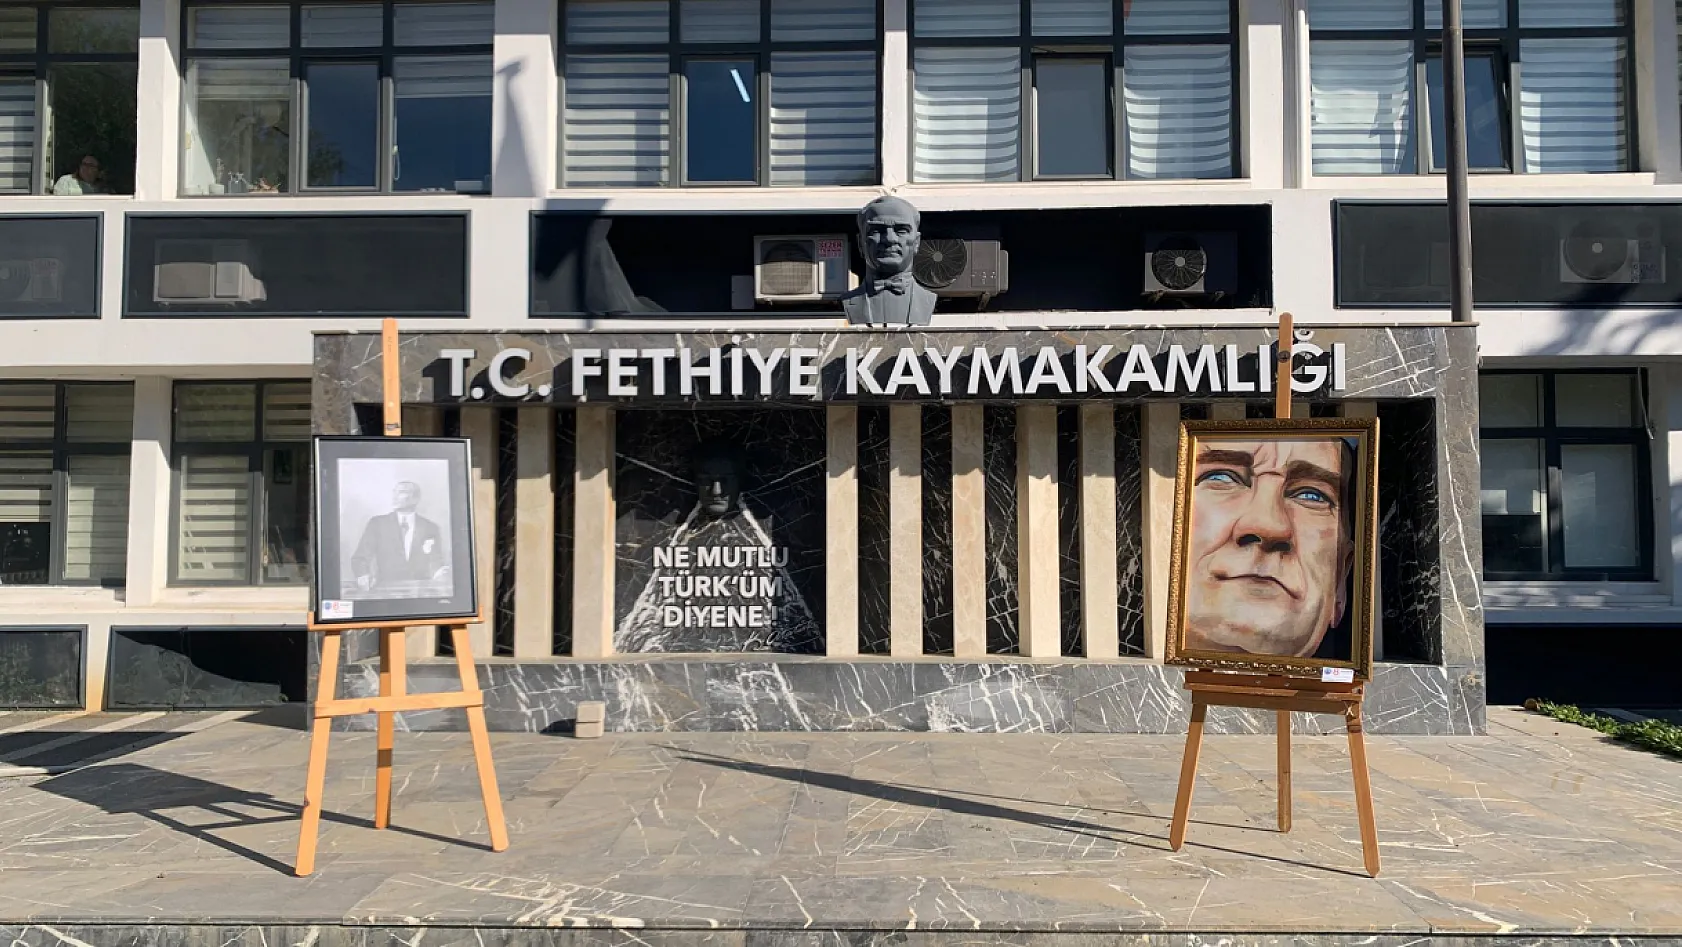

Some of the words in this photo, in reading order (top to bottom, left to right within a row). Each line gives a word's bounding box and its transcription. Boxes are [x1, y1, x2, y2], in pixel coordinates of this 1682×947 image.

[440, 347, 552, 399] T.C.
[571, 335, 820, 397] FETHİYE
[845, 328, 1347, 395] KAYMAKAMLIĞI
[652, 546, 690, 567] NE
[696, 546, 789, 568] MUTLU
